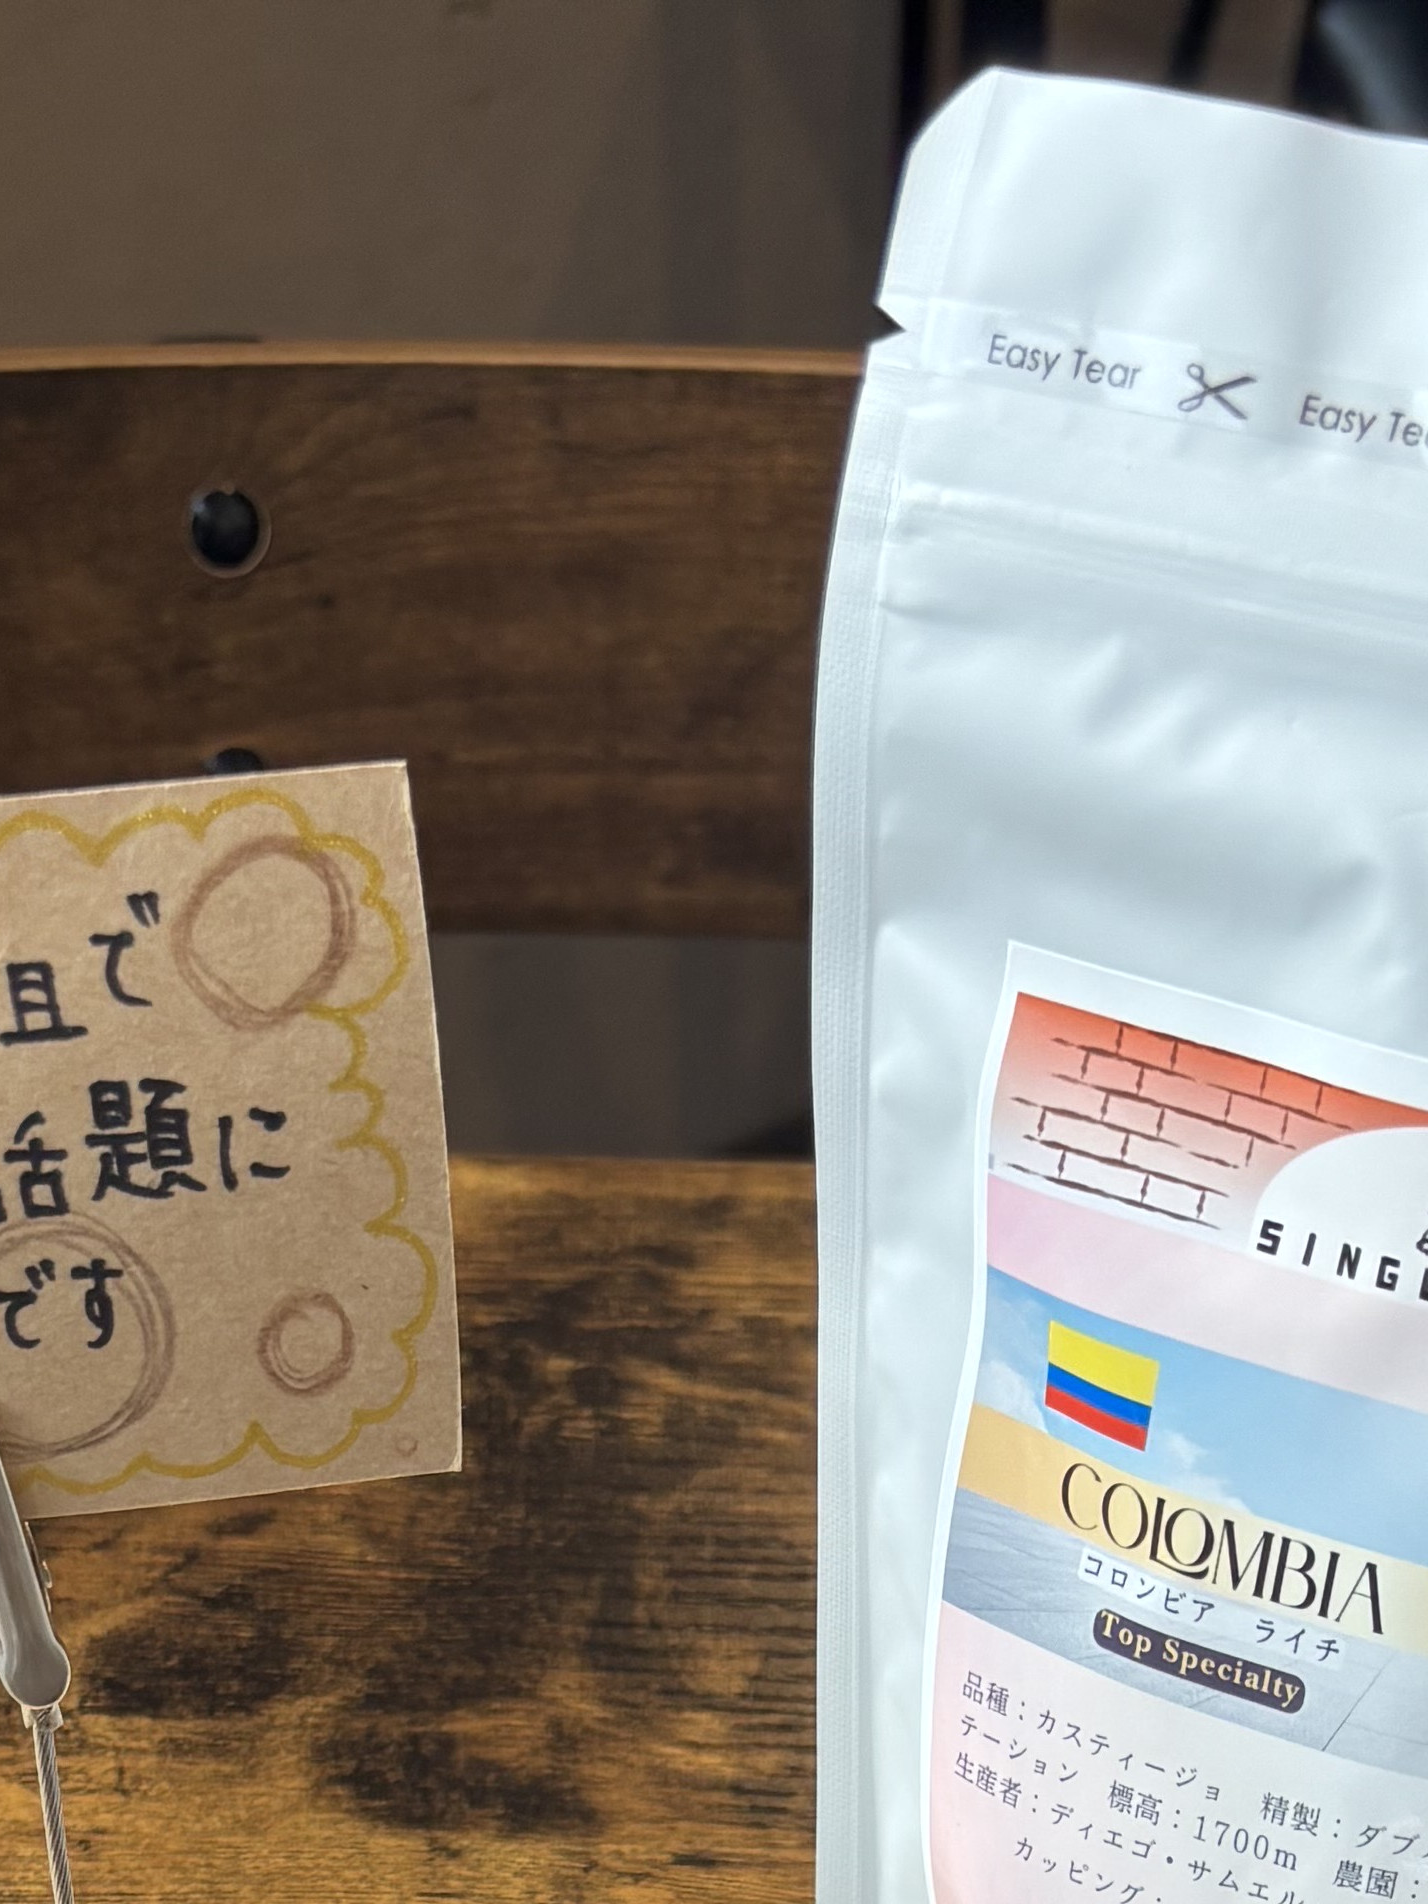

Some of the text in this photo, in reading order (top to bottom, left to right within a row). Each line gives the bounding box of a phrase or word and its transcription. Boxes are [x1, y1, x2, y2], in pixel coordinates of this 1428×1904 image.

[987, 334, 1061, 381] Easy
[1072, 348, 1142, 390] Tear
[1299, 393, 1375, 442] Easy
[1061, 1462, 1384, 1636] COLOMBIA
[1083, 1553, 1340, 1663] コロンビア ライチ
[1098, 1610, 1301, 1709] Top Specialty
[961, 1714, 1079, 1783] テーション
